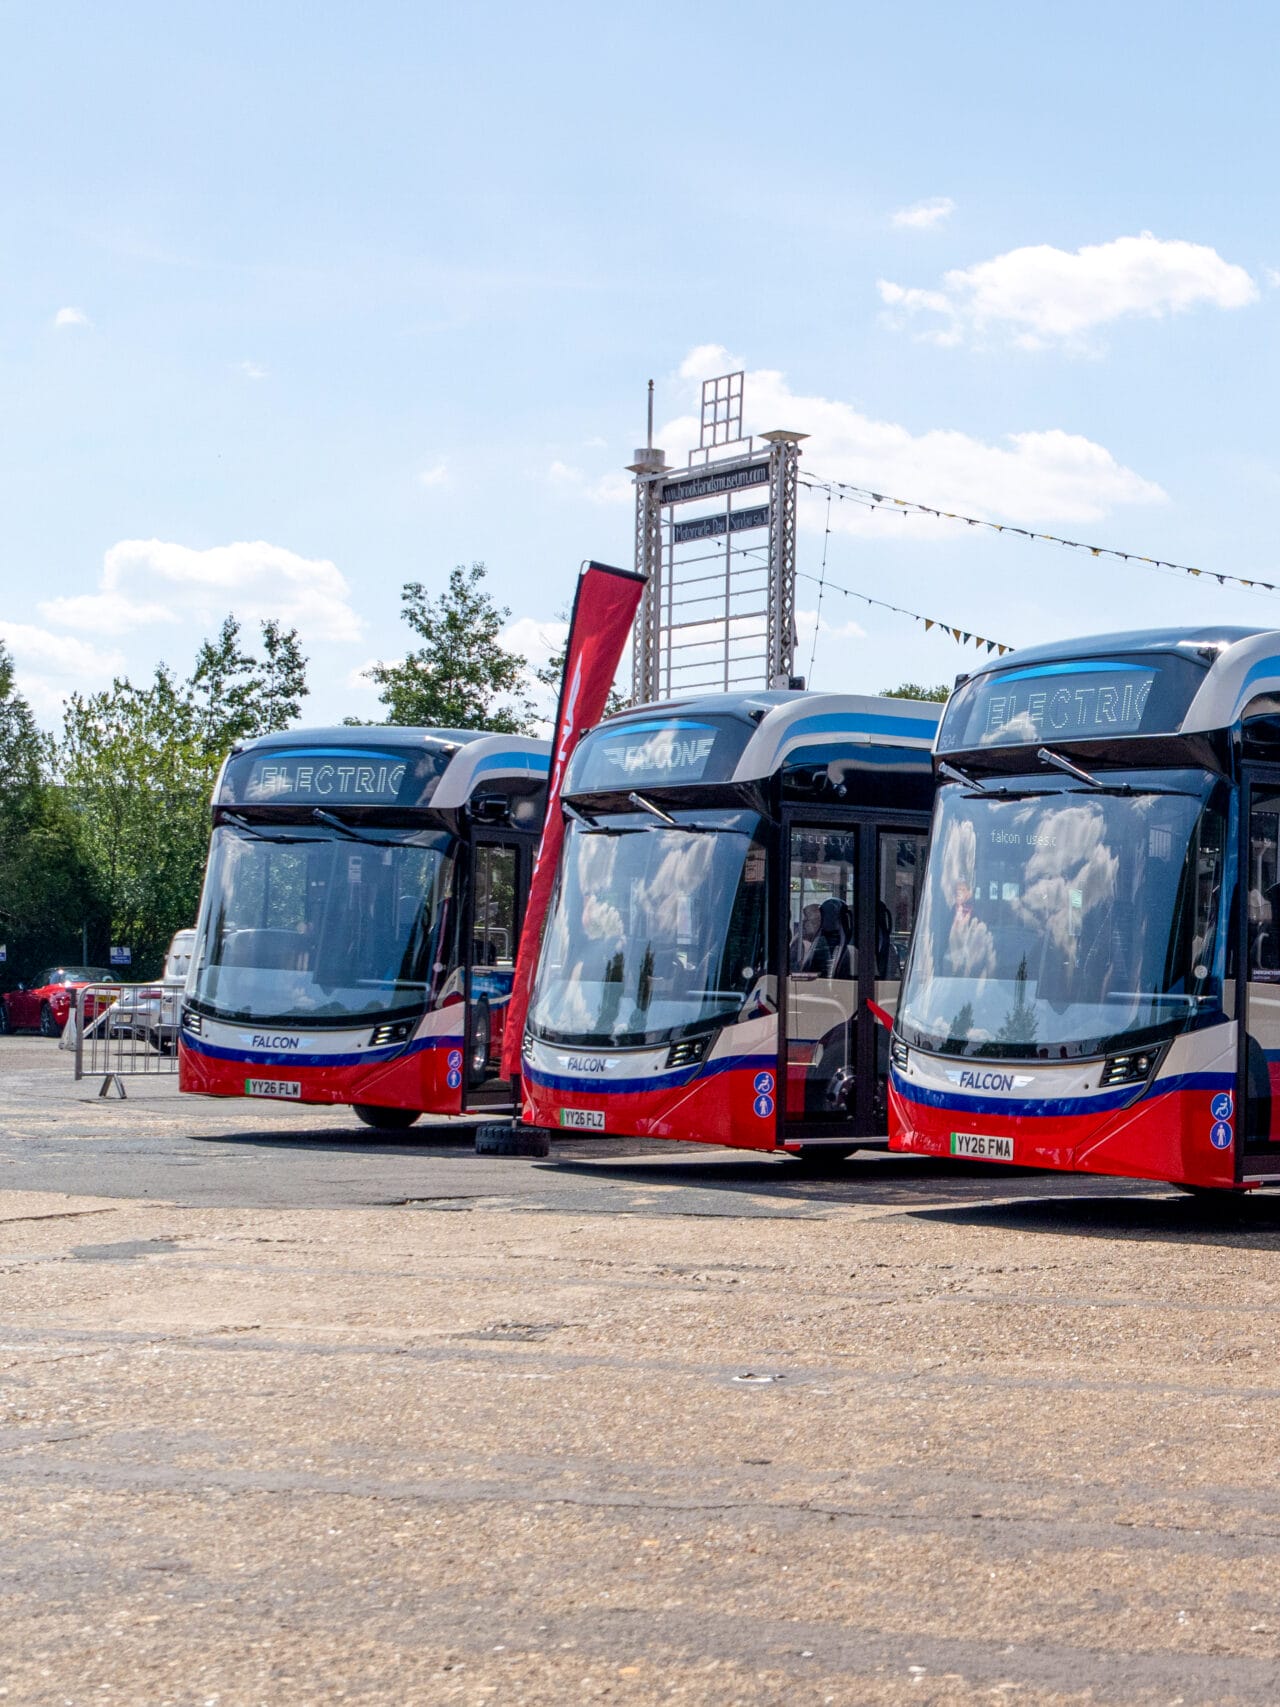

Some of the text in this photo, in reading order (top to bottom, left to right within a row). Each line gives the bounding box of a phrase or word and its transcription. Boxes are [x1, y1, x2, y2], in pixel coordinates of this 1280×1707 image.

[625, 741, 697, 772] FALCON
[260, 765, 406, 794] ELECTRIC
[252, 1035, 300, 1048] FALCON
[567, 1057, 607, 1072] FALCON
[251, 1081, 276, 1094] YY26
[960, 1071, 1014, 1091] FALCON
[565, 1110, 603, 1127] YY26 FLZ
[957, 1135, 1011, 1157] YY26 FMA
